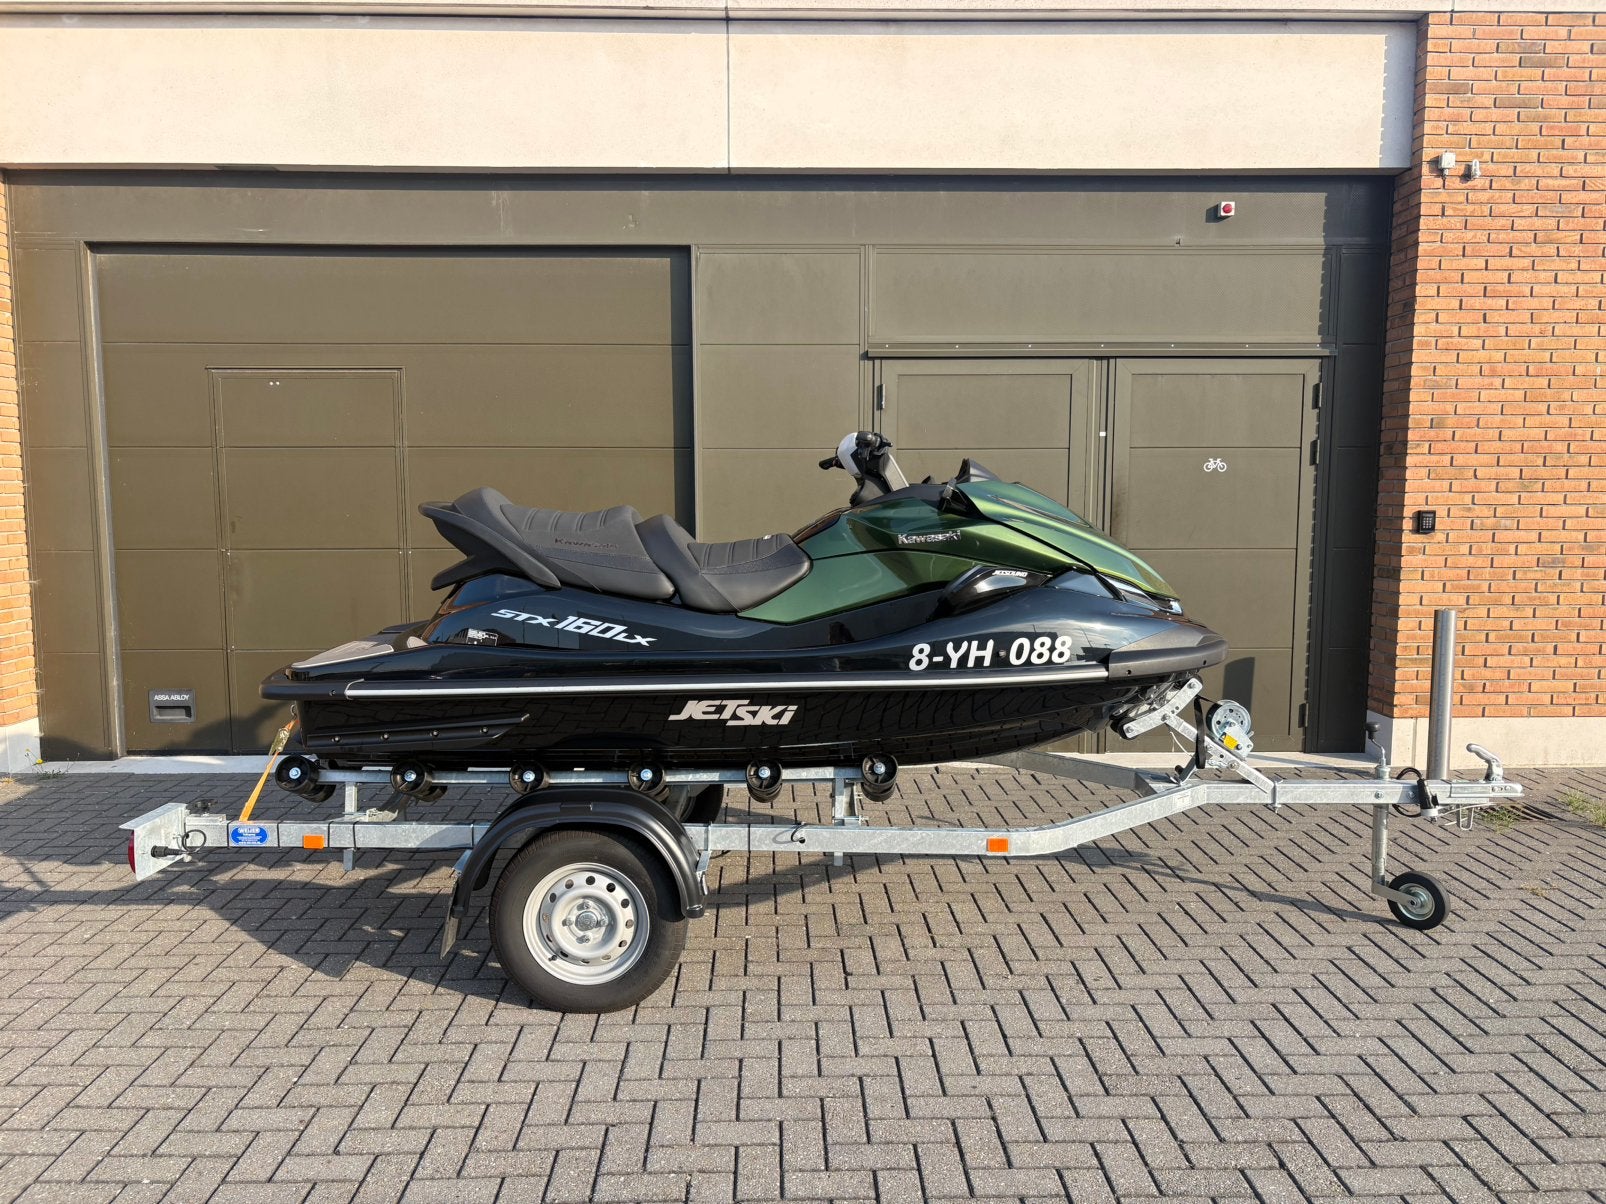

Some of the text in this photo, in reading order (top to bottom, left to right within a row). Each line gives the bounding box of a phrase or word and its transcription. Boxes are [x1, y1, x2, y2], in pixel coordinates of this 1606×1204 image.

[898, 529, 962, 545] Kawasaki
[491, 609, 559, 627] STX
[908, 635, 1072, 671] 8-YH 088
